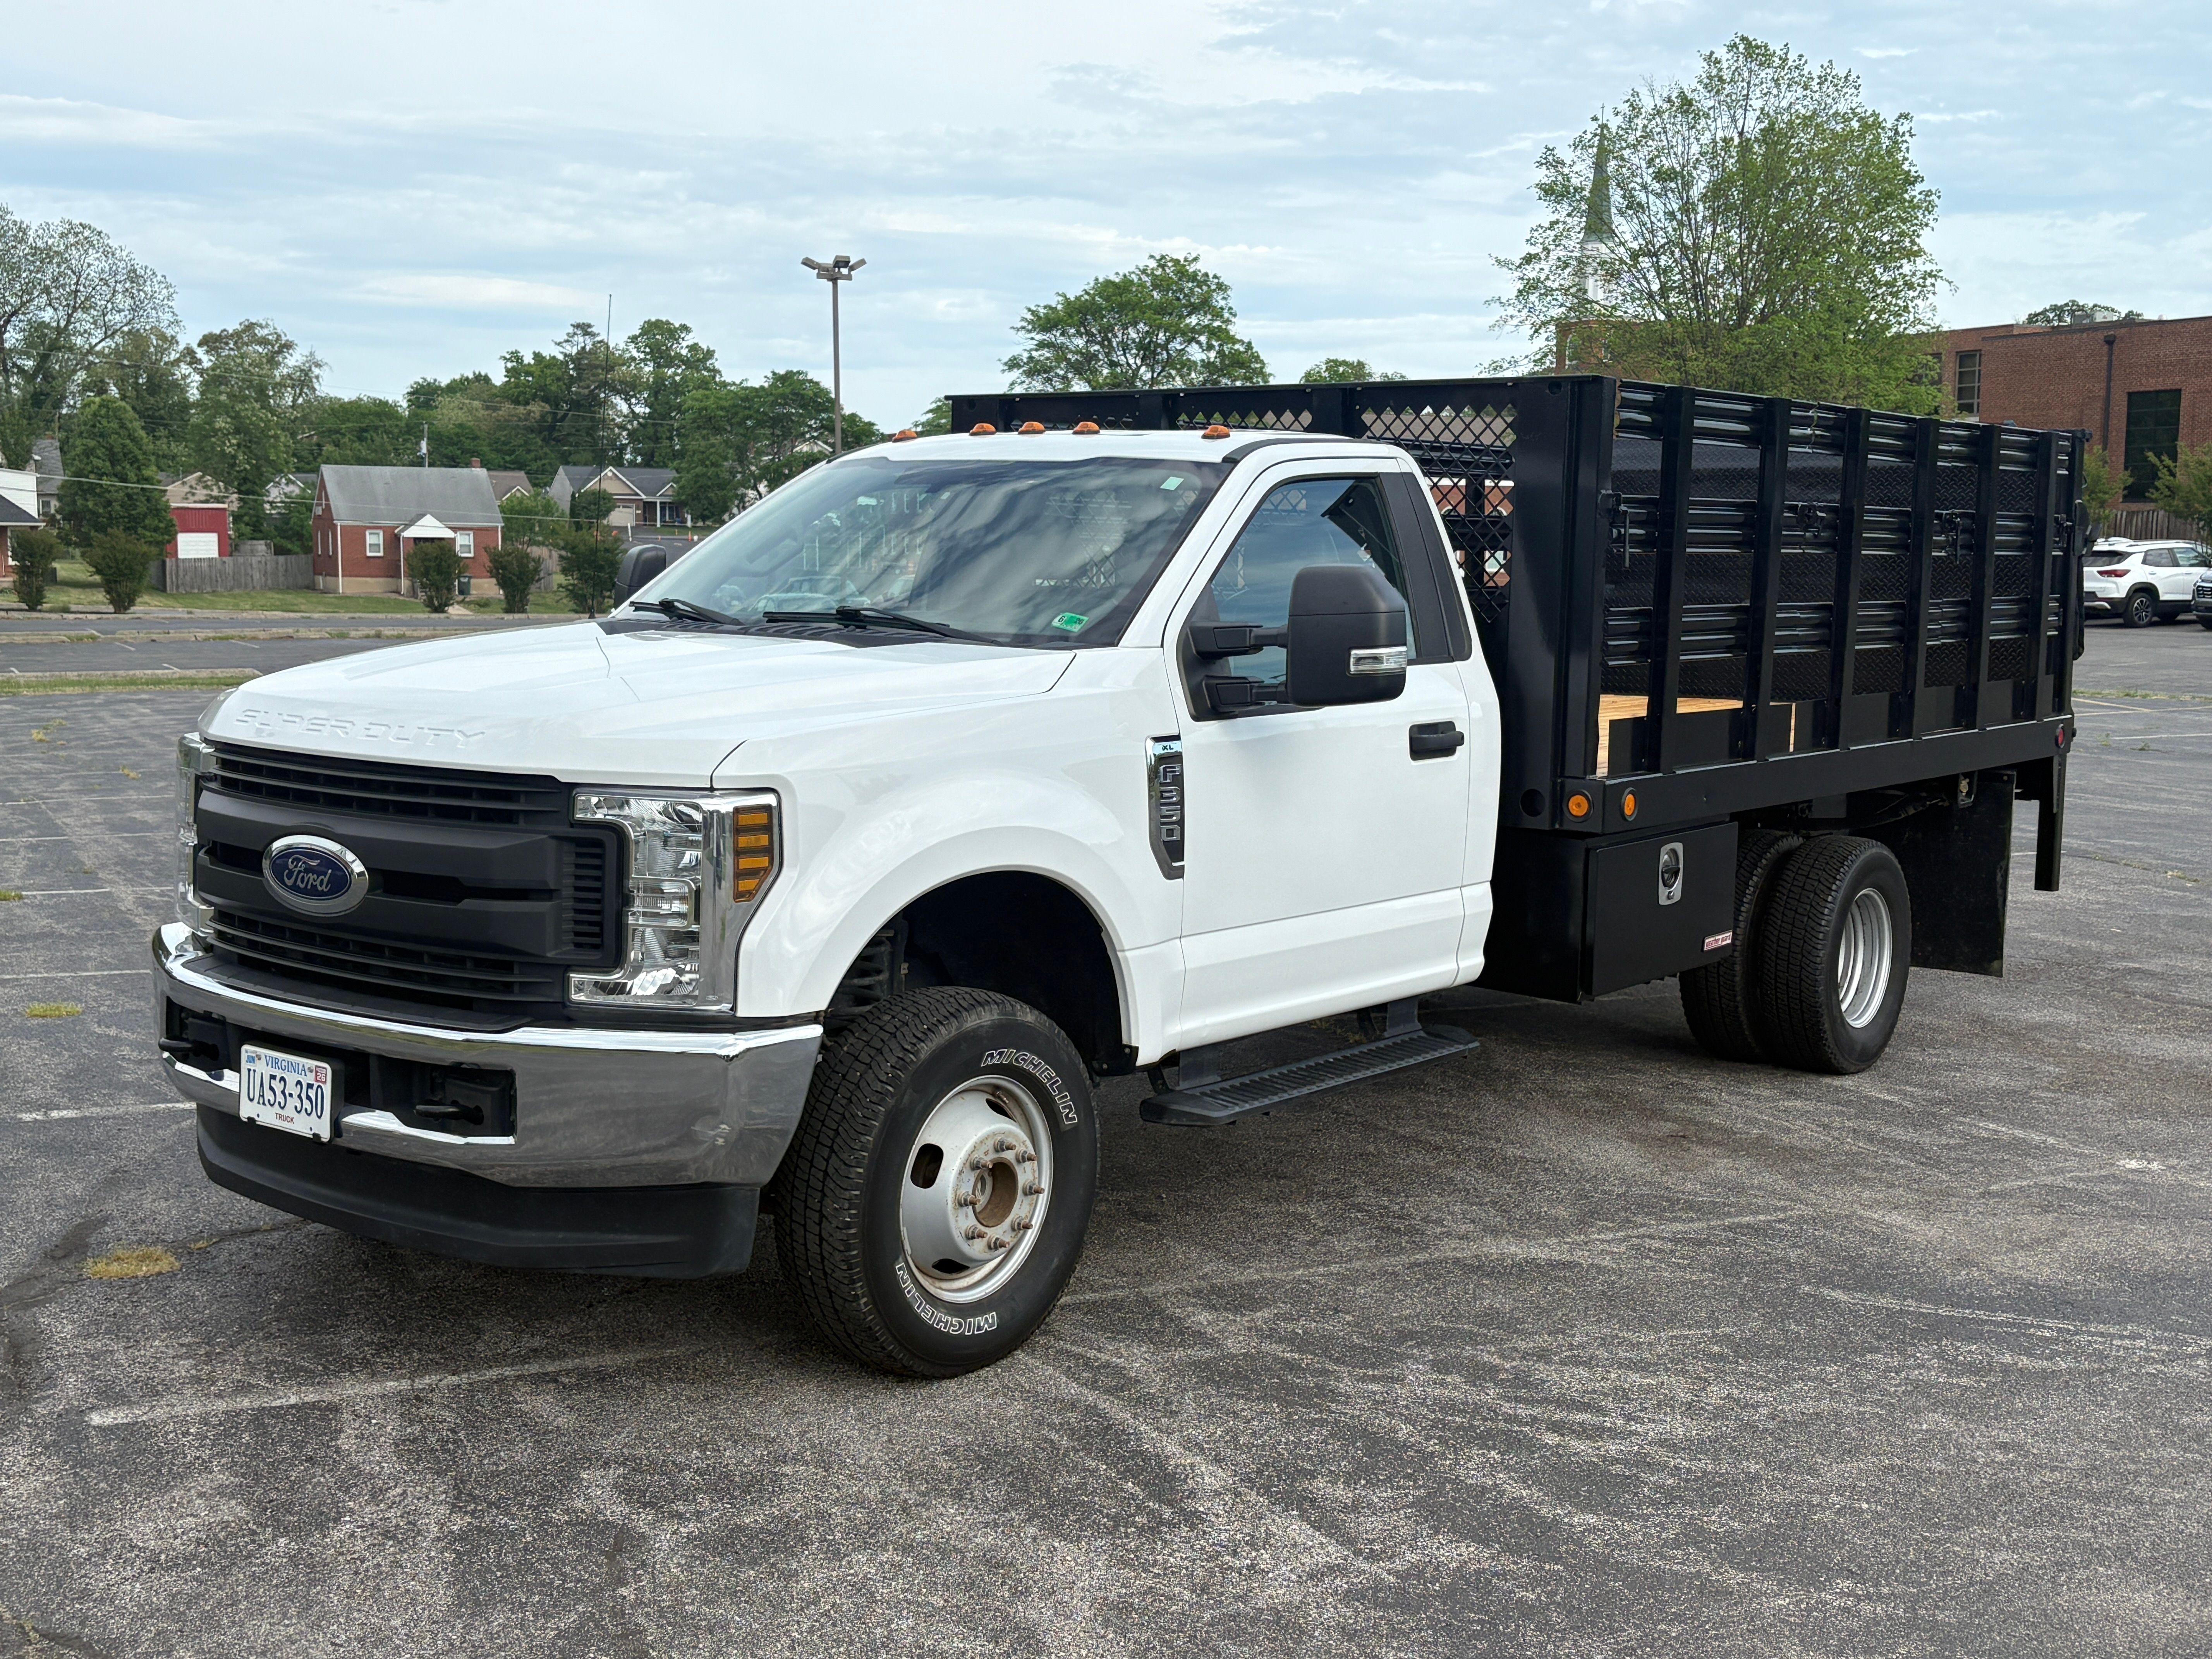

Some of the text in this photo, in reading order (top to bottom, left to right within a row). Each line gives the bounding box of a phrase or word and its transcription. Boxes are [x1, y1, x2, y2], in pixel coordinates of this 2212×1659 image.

[234, 709, 485, 748] SUPER DUTY
[283, 855, 332, 892] Ford
[264, 1055, 307, 1077] VIRGINIA
[316, 1072, 326, 1082] 26
[247, 1068, 325, 1119] UA53-350
[981, 1049, 1078, 1124] MICHELIN
[275, 1112, 295, 1124] TRUCK
[895, 1262, 997, 1335] MICHELIN
